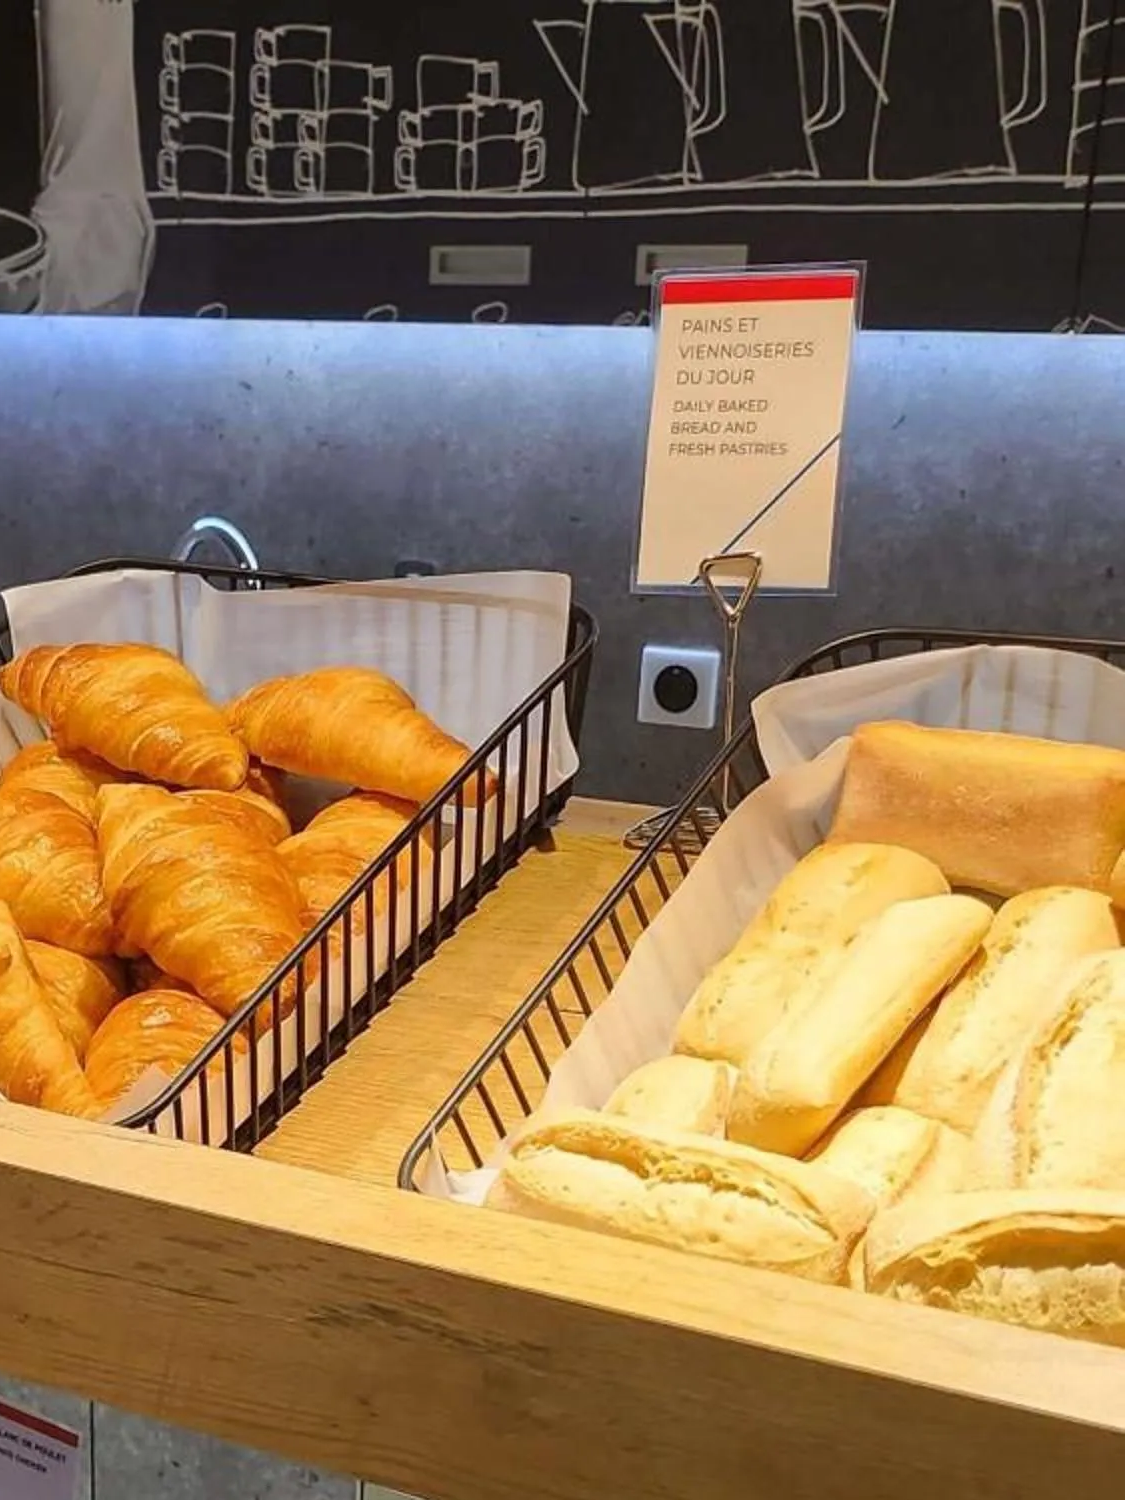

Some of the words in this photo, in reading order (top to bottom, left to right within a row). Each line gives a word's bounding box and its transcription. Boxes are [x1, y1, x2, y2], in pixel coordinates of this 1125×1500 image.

[682, 318, 733, 334] PAINS
[738, 317, 760, 333] ET
[678, 341, 815, 361] VIENNOISERIES
[676, 370, 702, 385] DU
[706, 369, 755, 385] JOUR
[673, 400, 714, 413] DAILY
[718, 399, 768, 413] BAKED
[670, 421, 721, 435] BREAD
[724, 421, 757, 434] AND
[668, 444, 715, 457] FRESH
[720, 443, 789, 457] PASTRIES
